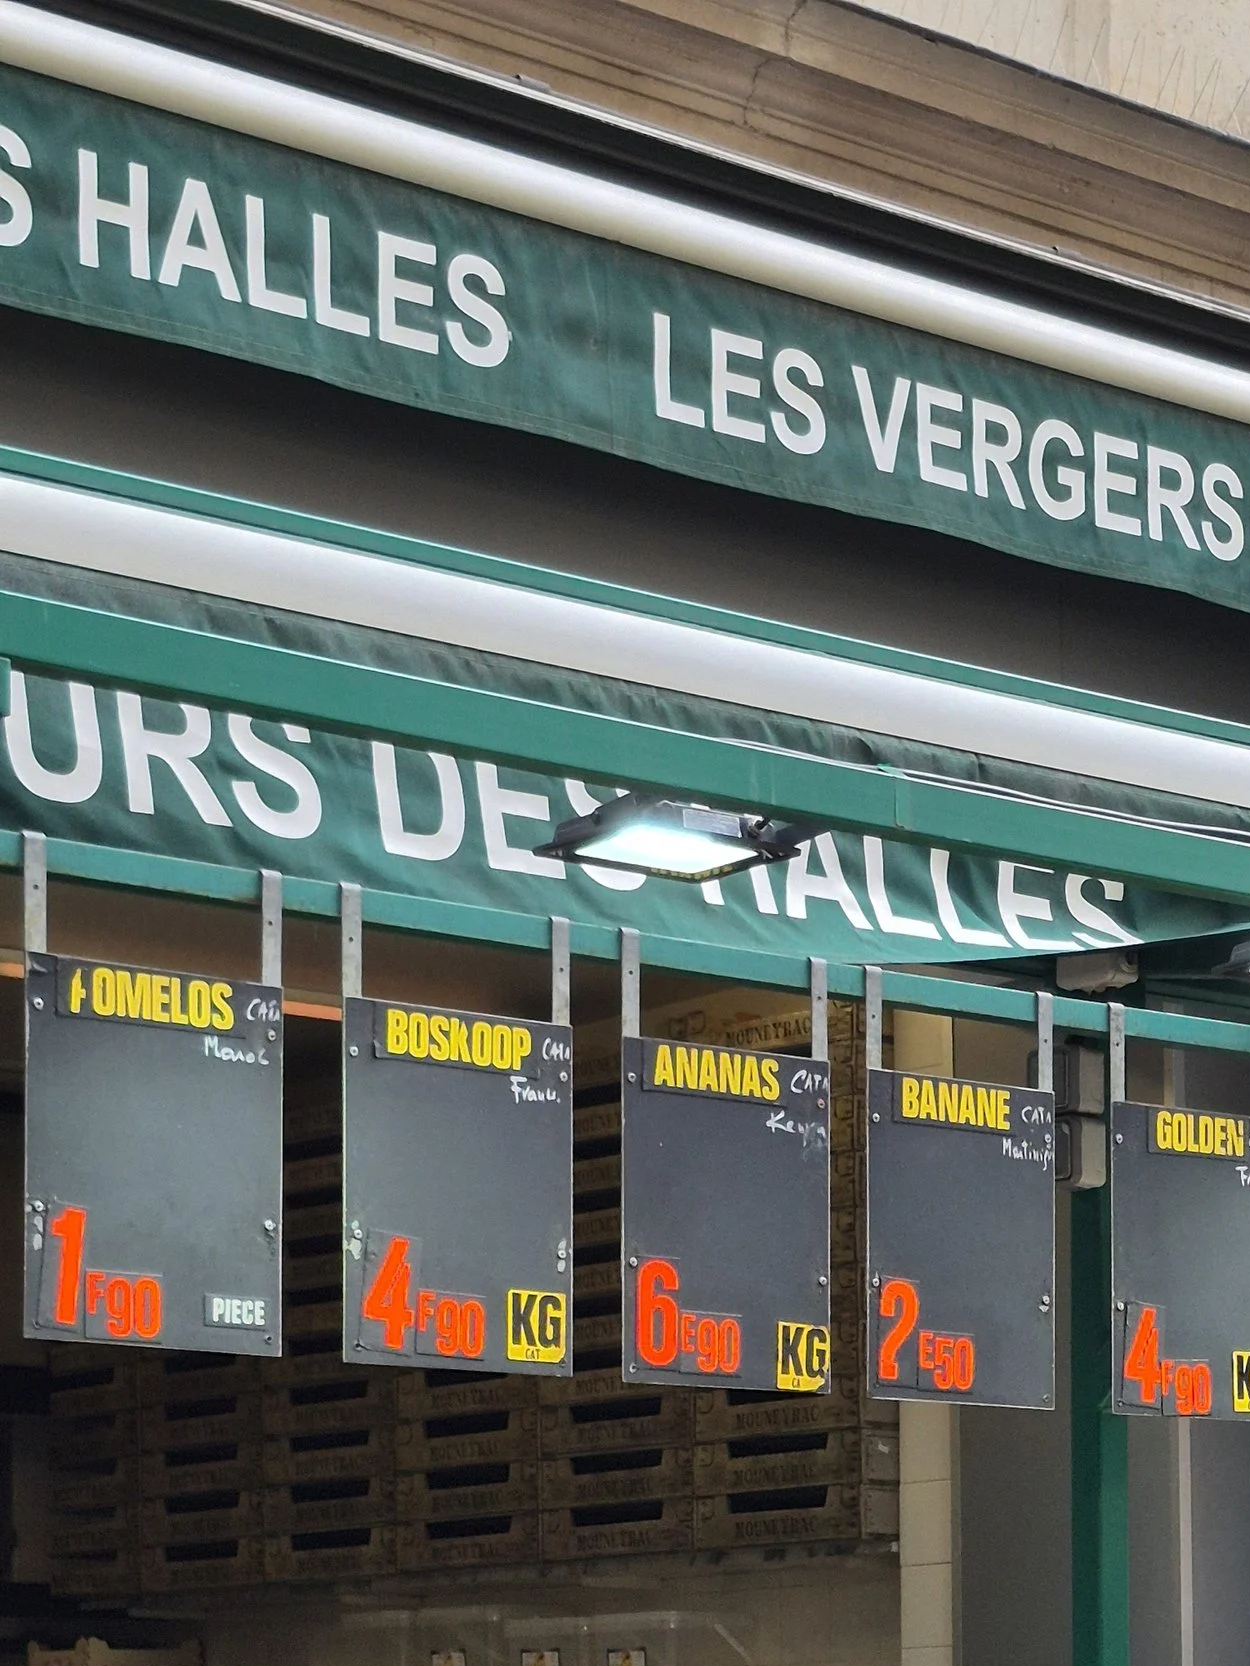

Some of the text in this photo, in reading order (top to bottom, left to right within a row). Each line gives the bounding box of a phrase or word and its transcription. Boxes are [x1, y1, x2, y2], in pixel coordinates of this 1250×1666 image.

[77, 147, 513, 368] HALLES
[651, 312, 827, 456] LES
[851, 365, 1245, 563] VERGERS
[386, 1008, 532, 1071] BOSKOOP
[653, 1044, 781, 1101] ANANAS
[902, 1077, 1011, 1132] BANANE
[1156, 1110, 1245, 1157] GOLDEN
[212, 1297, 266, 1327] PIECE
[511, 1292, 562, 1350] KG
[780, 1325, 828, 1379] KG
